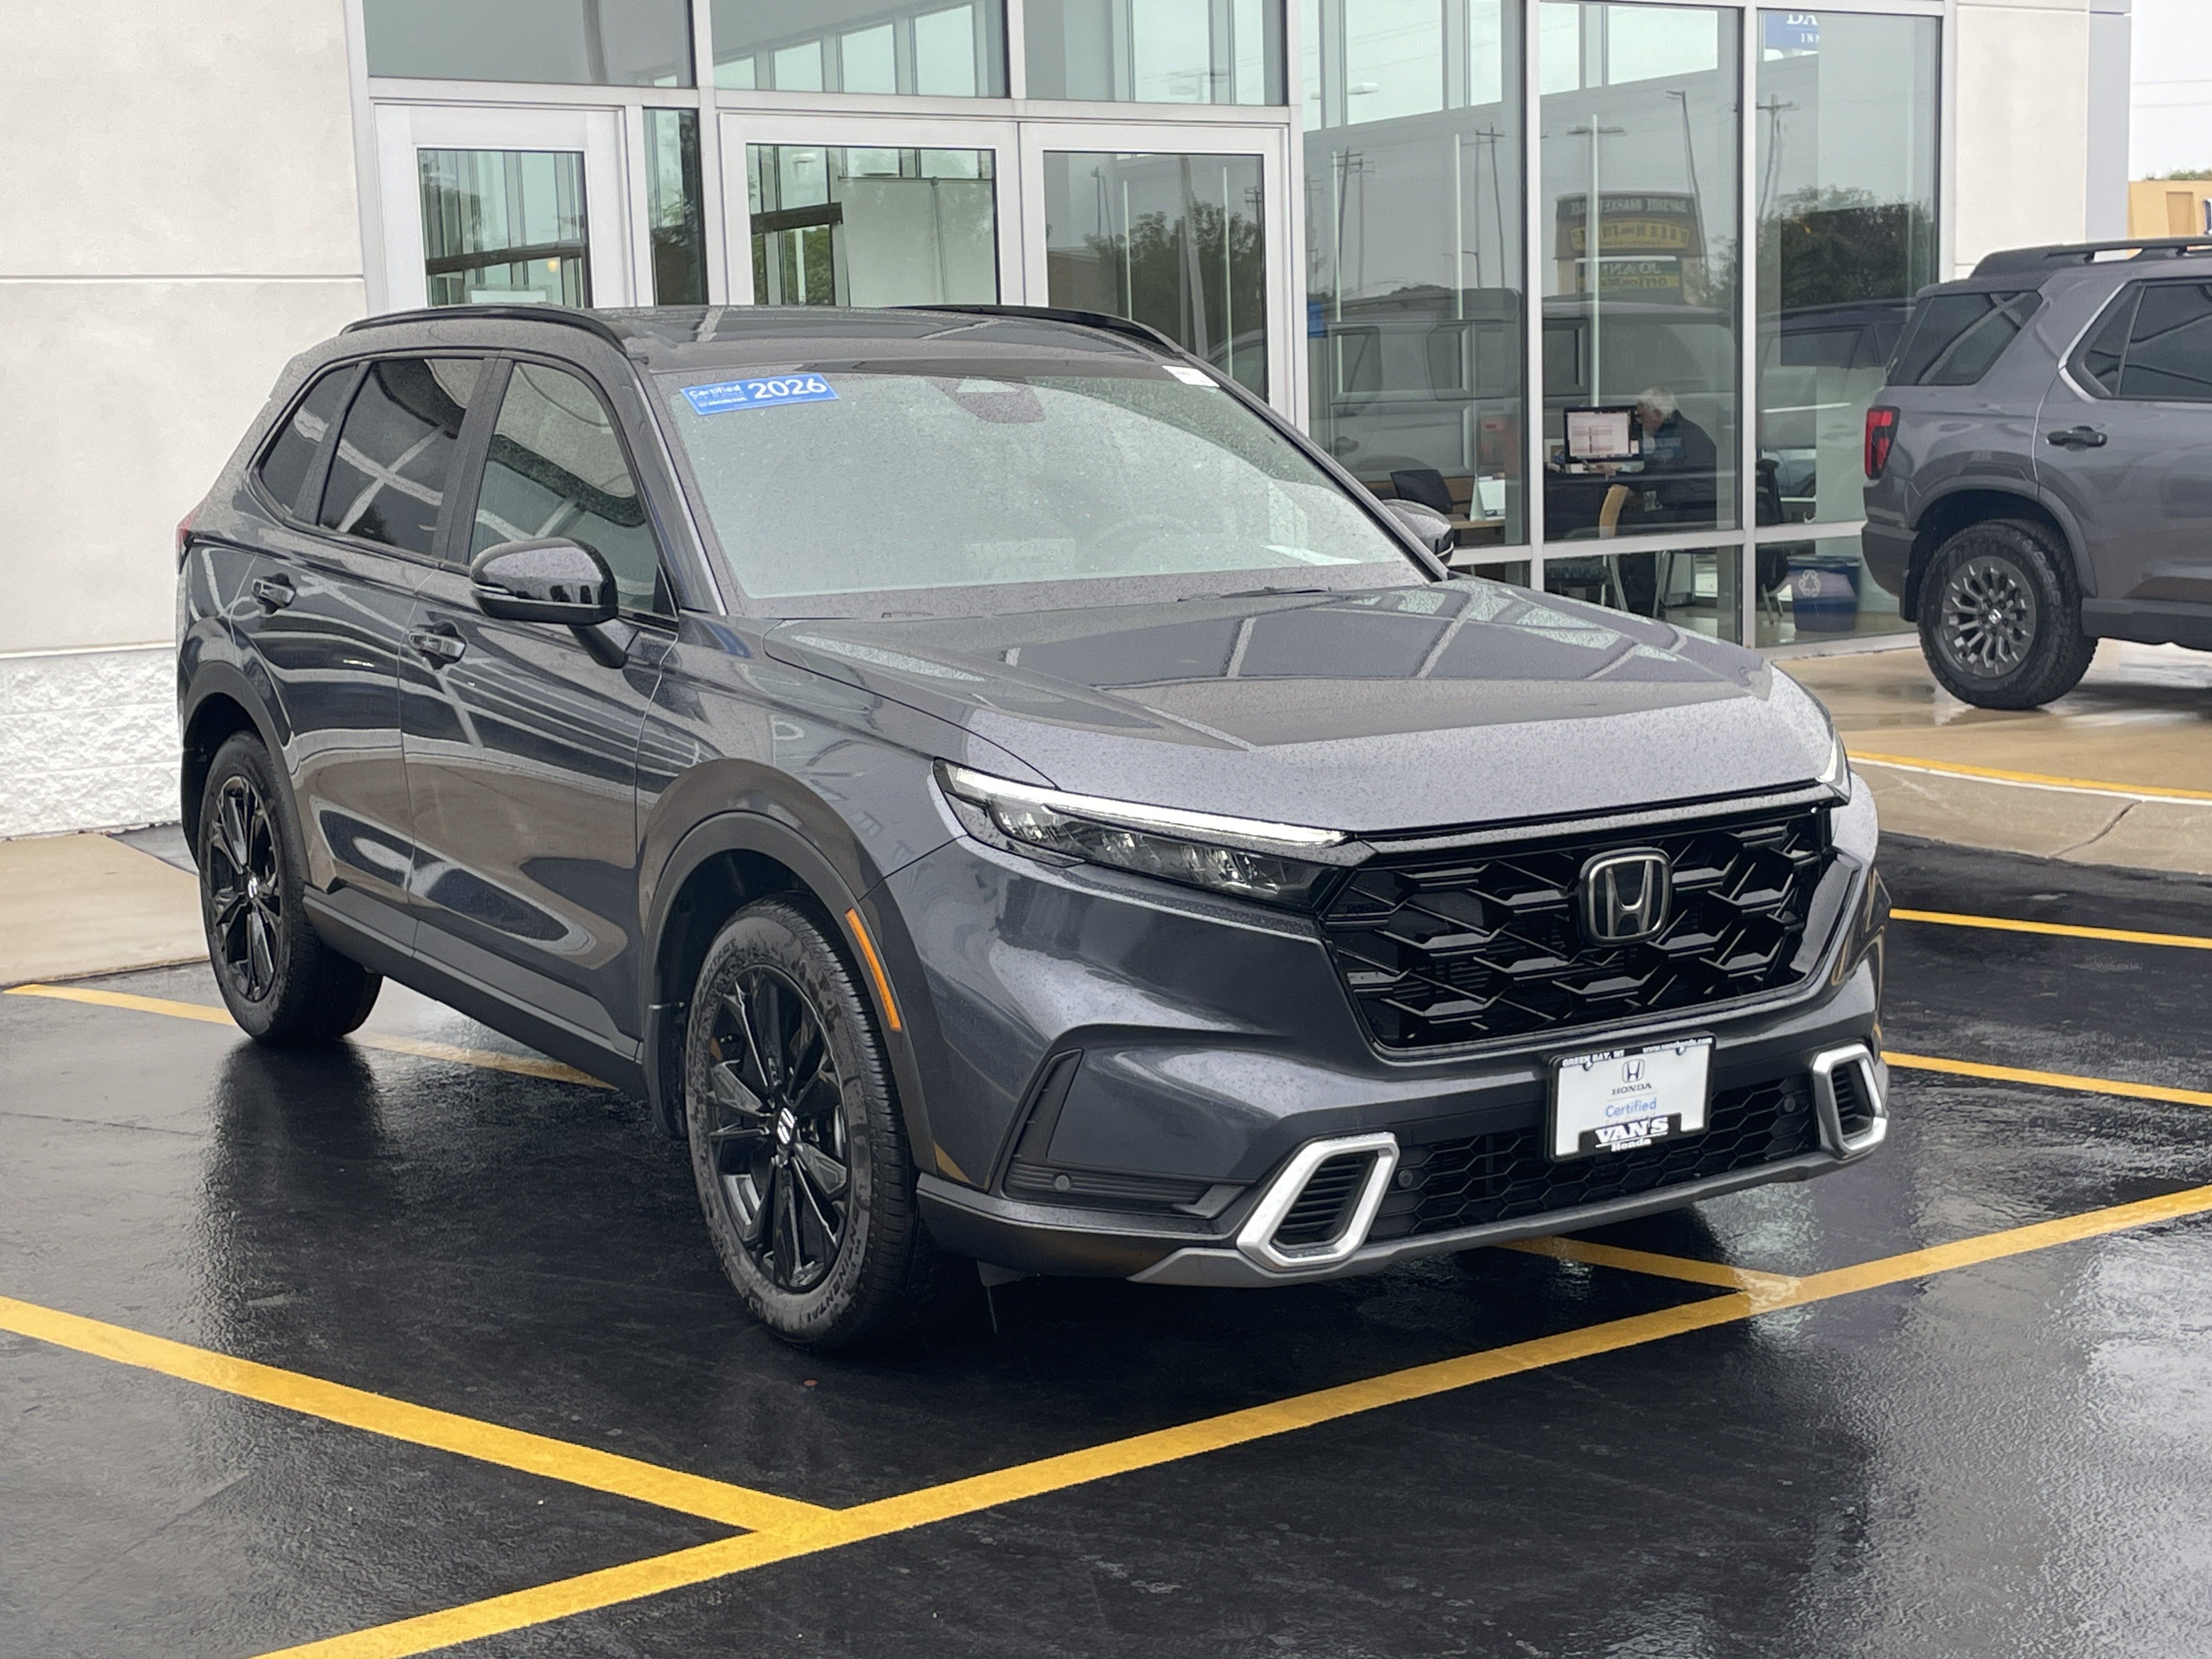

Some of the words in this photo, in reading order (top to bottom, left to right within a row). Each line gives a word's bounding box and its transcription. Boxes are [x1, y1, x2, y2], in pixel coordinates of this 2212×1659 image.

[748, 377, 827, 399] 2026
[1612, 1083, 1651, 1095] HONDA
[1605, 1097, 1657, 1118] Certified
[1611, 1138, 1651, 1152] Honda
